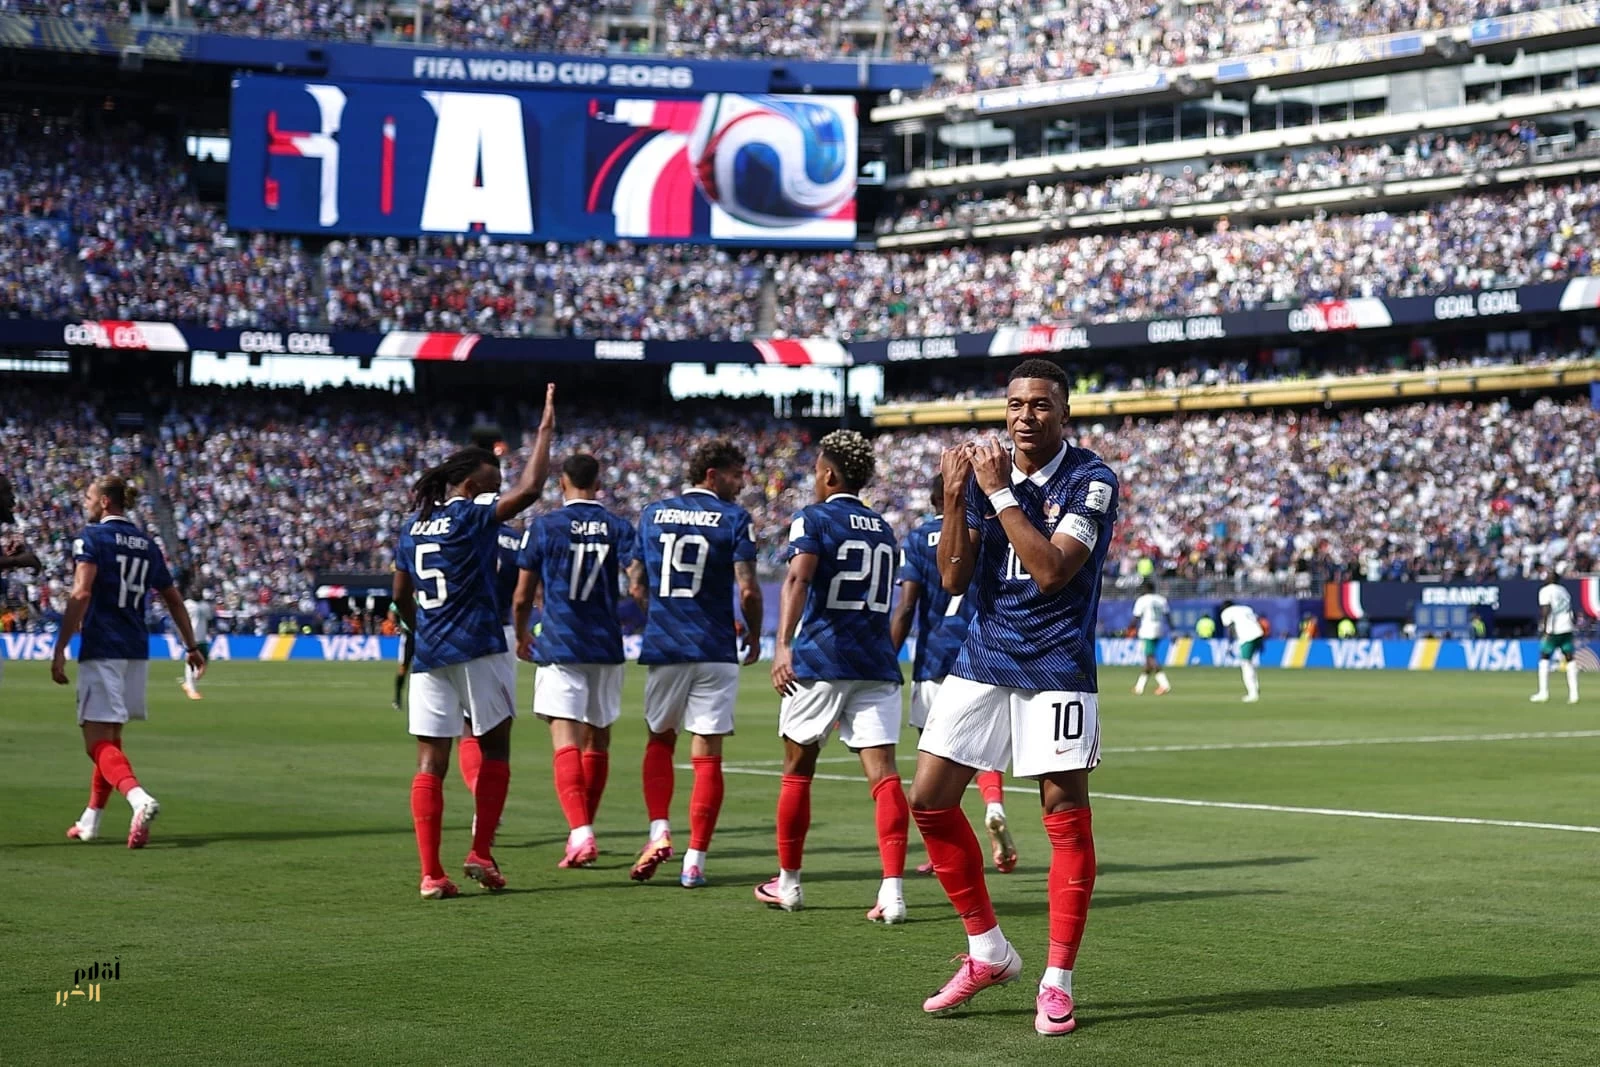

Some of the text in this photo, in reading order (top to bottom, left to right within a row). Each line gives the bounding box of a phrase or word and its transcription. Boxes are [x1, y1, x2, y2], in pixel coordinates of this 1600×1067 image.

[413, 56, 693, 88] FIFA WORLD CUP 2026
[240, 331, 333, 354] GOAL GOAL
[115, 554, 149, 609] 14
[415, 543, 447, 610] 5
[569, 542, 610, 601] 17
[658, 532, 710, 598] 19
[826, 539, 894, 614] 20
[1422, 587, 1499, 605] FRANCE
[319, 635, 382, 661] VISA
[1328, 640, 1385, 669] VISA
[1460, 640, 1523, 669] VISA
[1052, 700, 1083, 741] 10
